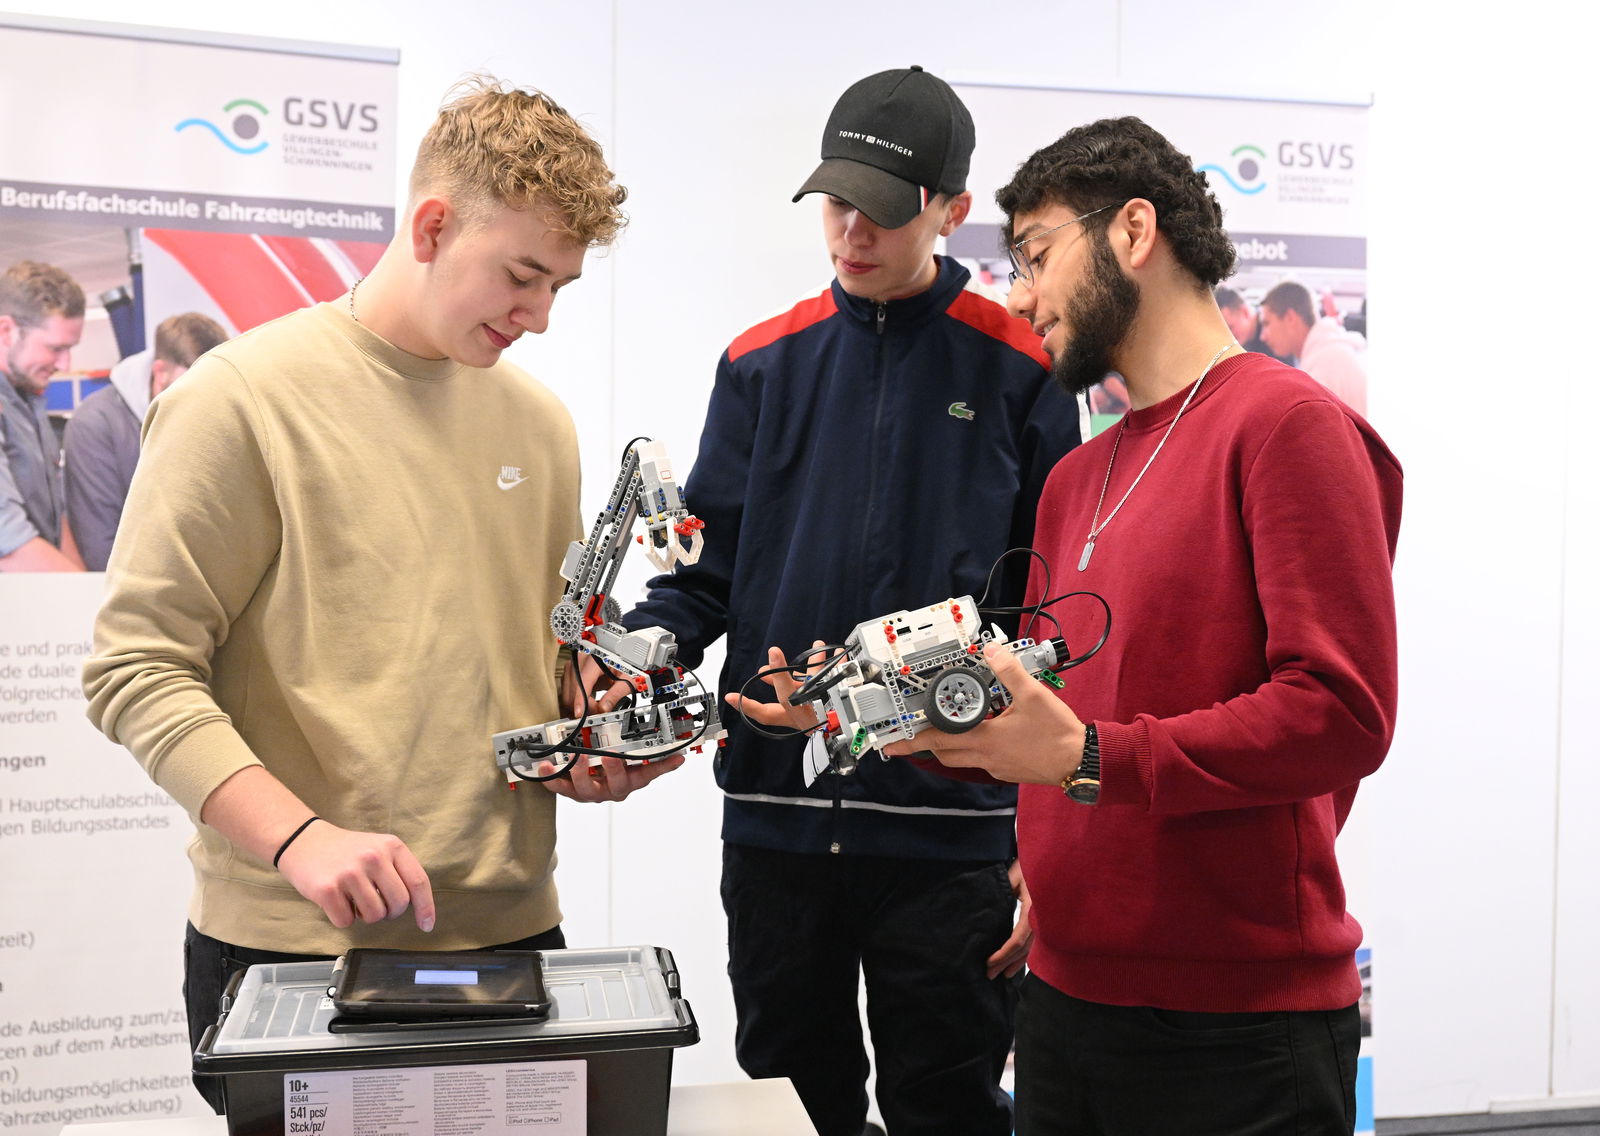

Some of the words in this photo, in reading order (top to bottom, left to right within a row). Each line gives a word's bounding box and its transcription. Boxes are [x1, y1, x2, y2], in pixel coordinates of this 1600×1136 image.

[283, 97, 379, 133] GSVS
[838, 130, 867, 141] TOMMY
[876, 138, 913, 157] HILFIGER
[1278, 141, 1354, 170] GSVS
[1, 187, 200, 220] Berufsfachschule
[205, 201, 384, 231] Fahrzeugtechnik
[502, 465, 522, 481] NIKE
[16, 641, 49, 657] und
[28, 663, 76, 679] duale
[31, 813, 170, 837] Bildungsstandes
[28, 1013, 123, 1037] Ausbildung
[33, 1040, 61, 1058] auf
[66, 1037, 104, 1055] dem
[289, 1080, 309, 1092] 10+
[290, 1095, 309, 1103] 45544
[290, 1106, 306, 1119] 541
[310, 1106, 328, 1120] pcs/
[290, 1120, 325, 1134] Stck/pz/
